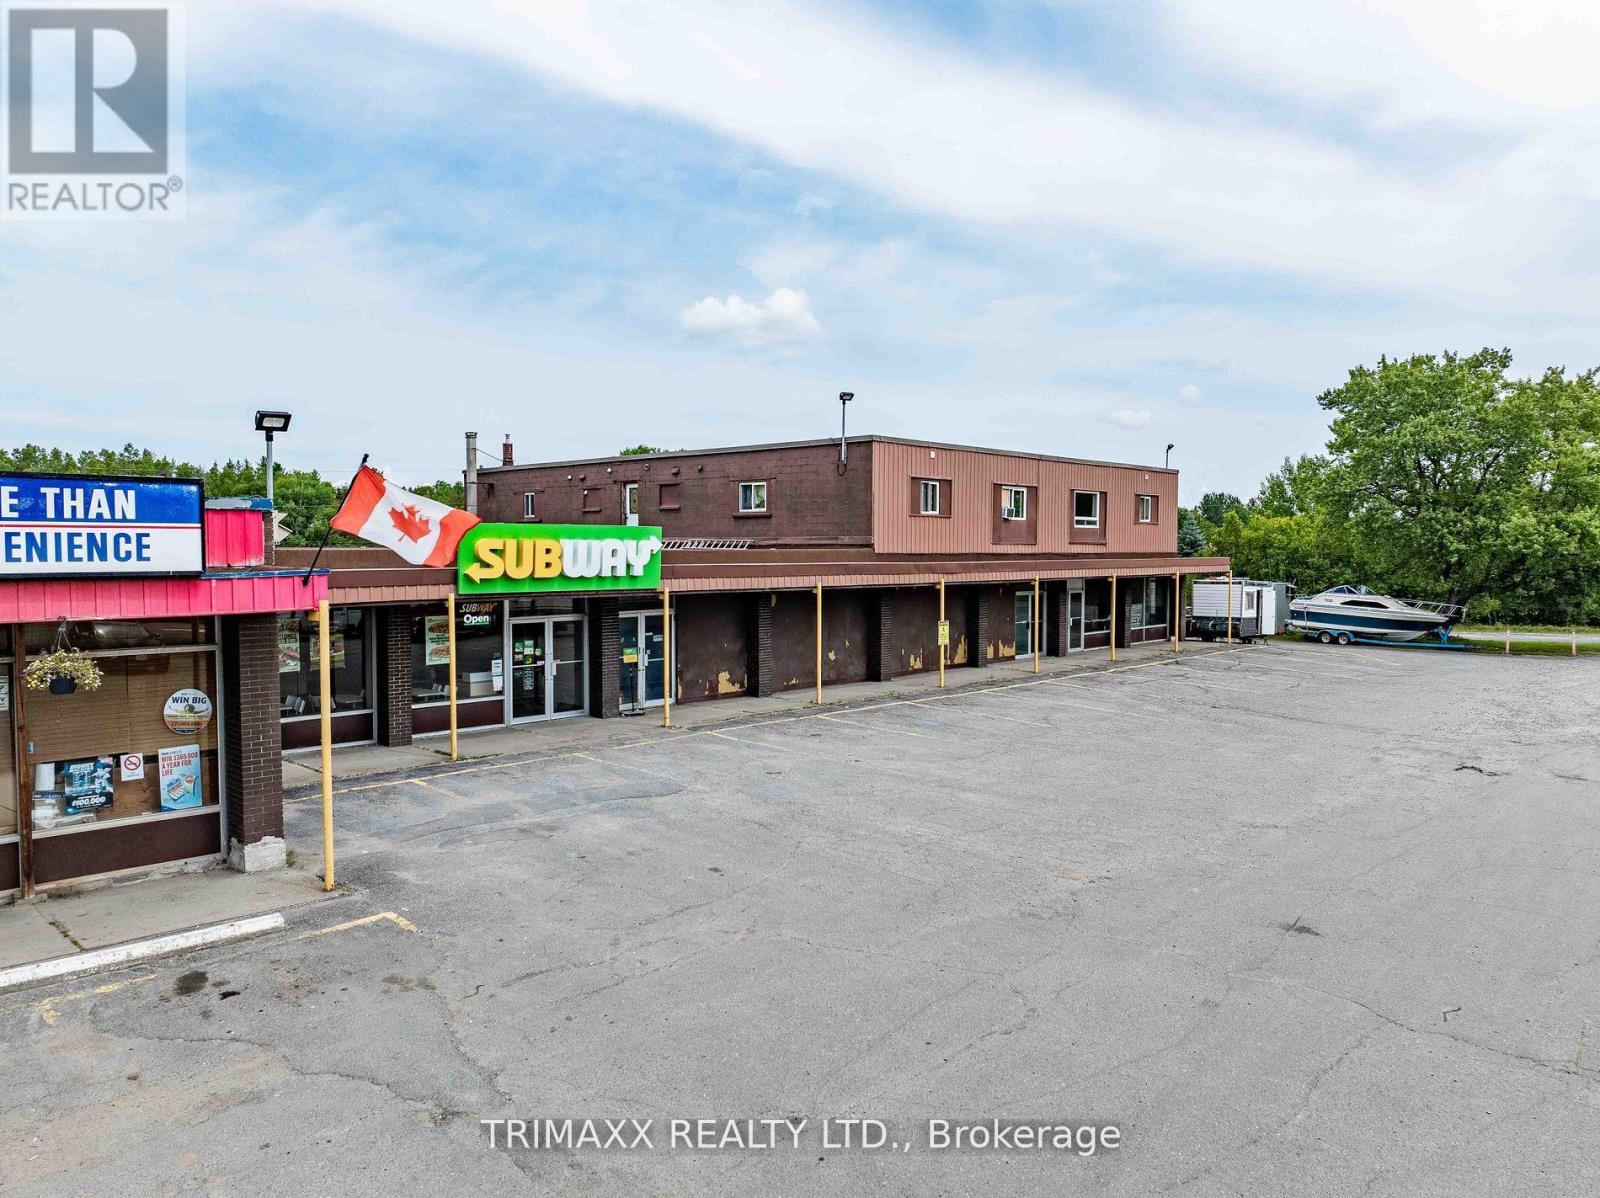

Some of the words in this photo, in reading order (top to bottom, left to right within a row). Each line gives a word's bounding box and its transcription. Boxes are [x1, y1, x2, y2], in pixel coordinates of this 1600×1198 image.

[40, 486, 137, 520] THAN
[4, 531, 151, 563] ENIENCE
[464, 535, 663, 584] SUBWAY
[459, 602, 498, 613] SUBWAY
[463, 614, 490, 625] Open
[171, 696, 190, 704] WIN
[191, 696, 207, 704] BIG
[161, 755, 173, 763] WIN
[167, 761, 181, 769] YEAR
[181, 759, 193, 767] FOR
[161, 769, 173, 777] LIFE
